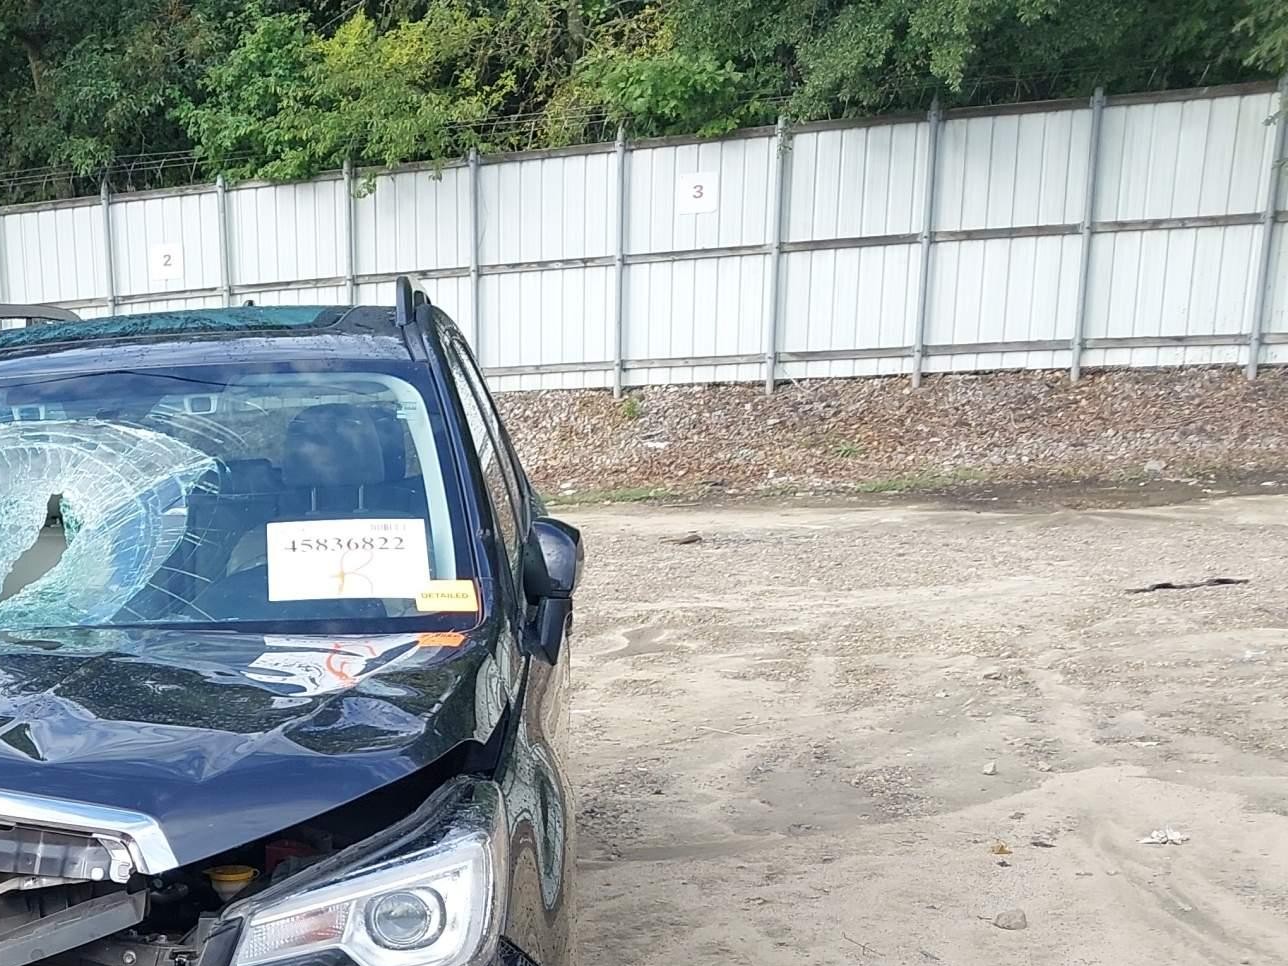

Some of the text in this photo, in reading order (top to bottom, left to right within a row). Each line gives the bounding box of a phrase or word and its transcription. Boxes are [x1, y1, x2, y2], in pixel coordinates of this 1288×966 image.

[692, 184, 704, 199] 3
[162, 254, 172, 267] 2
[284, 536, 407, 553] 45836822
[420, 591, 469, 600] DETAILED
